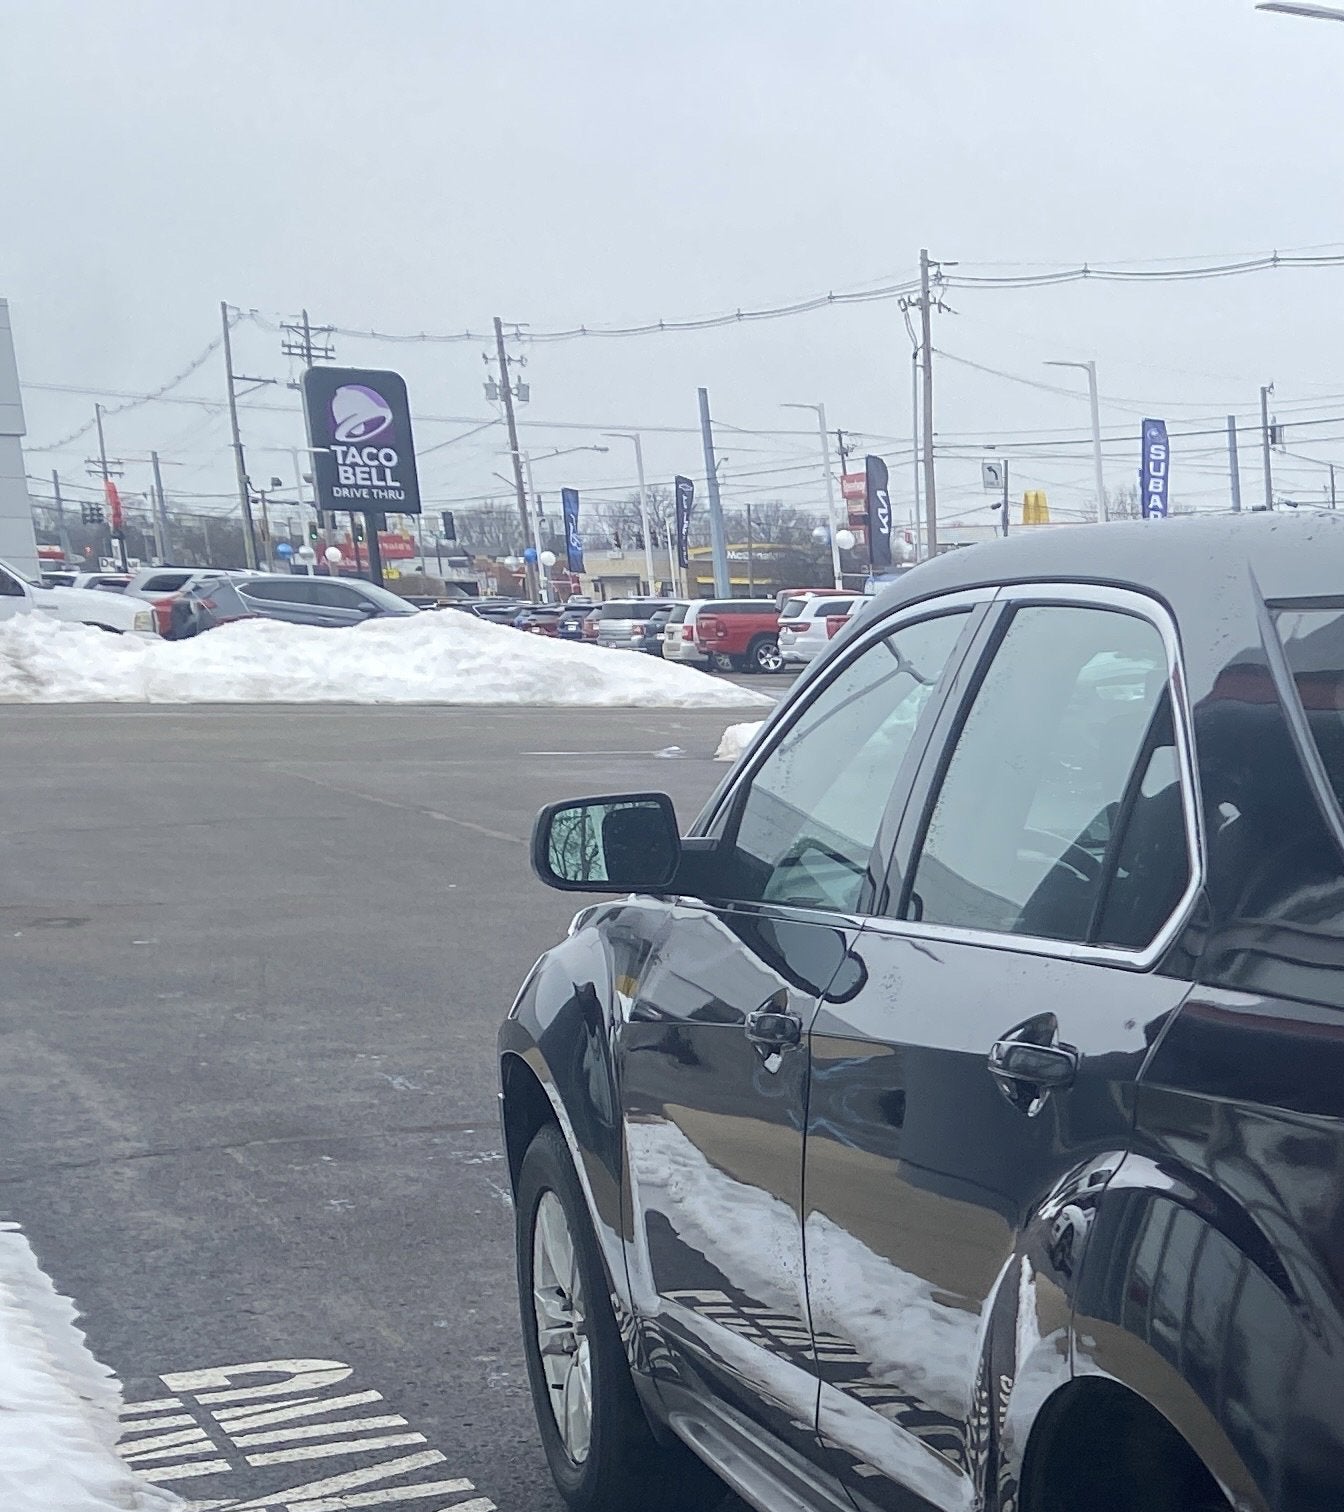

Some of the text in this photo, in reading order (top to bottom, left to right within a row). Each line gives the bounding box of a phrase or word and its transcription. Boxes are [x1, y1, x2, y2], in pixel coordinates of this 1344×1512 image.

[330, 444, 398, 467] TACO
[338, 465, 401, 487] BELL
[332, 487, 405, 500] DRIVE THRU
